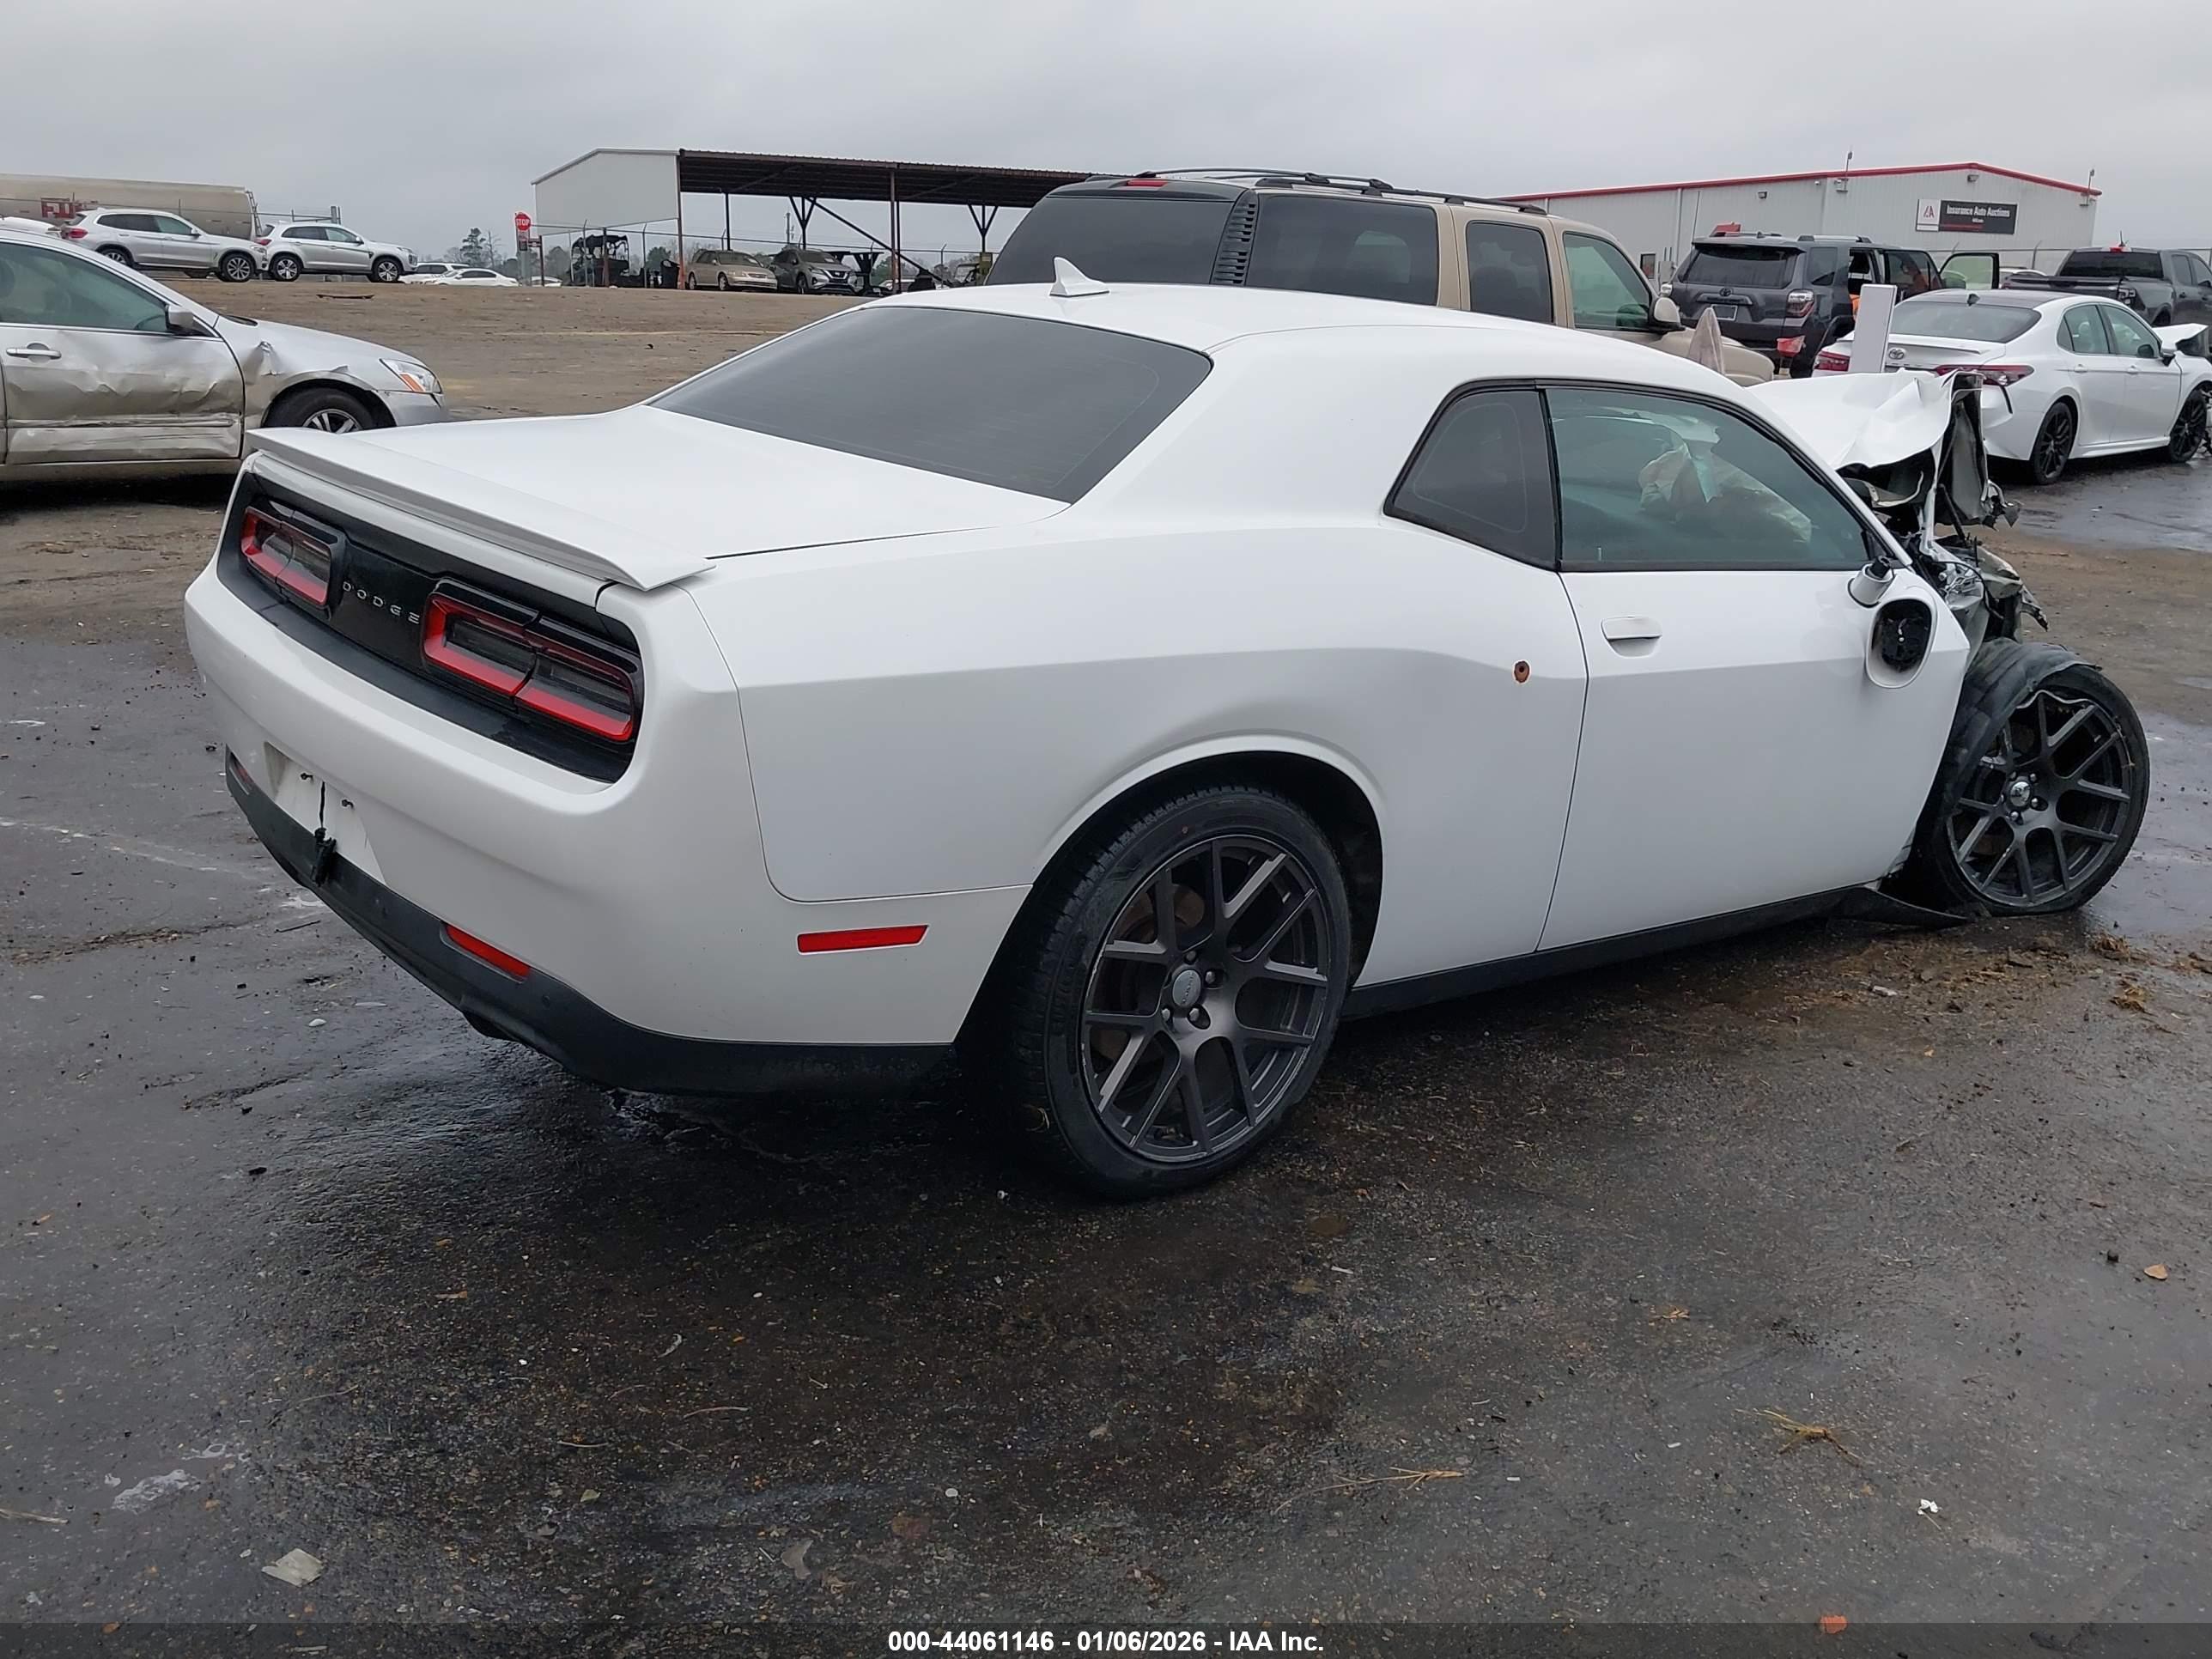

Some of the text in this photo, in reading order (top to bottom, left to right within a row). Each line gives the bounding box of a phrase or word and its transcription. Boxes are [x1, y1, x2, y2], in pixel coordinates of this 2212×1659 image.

[1973, 206, 1987, 216] Auto
[515, 218, 530, 227] STOP
[343, 581, 420, 624] DODGE
